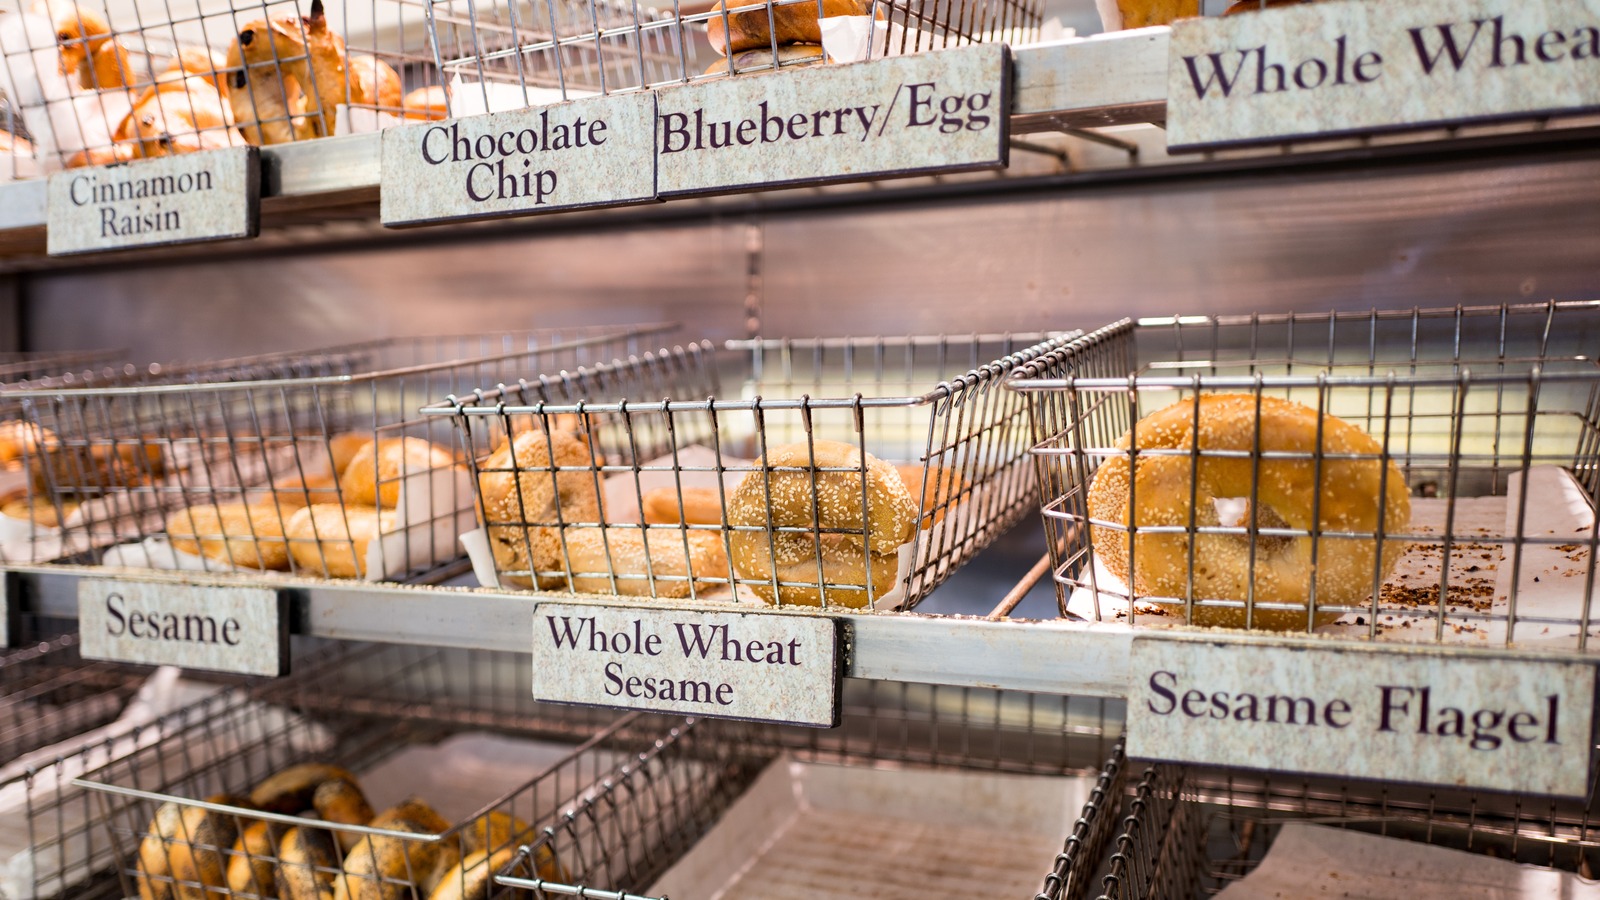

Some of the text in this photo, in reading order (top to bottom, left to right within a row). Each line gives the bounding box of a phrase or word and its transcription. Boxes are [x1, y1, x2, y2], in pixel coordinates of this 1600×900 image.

[1181, 35, 1383, 101] Whole
[421, 110, 608, 165] Chocolate
[660, 83, 991, 154] Blueberry/Egg
[69, 167, 213, 208] Cinnamon
[466, 157, 558, 205] Chip
[99, 203, 181, 238] Raisin
[105, 593, 241, 646] Sesame
[546, 615, 802, 667] Whole Wheat
[604, 662, 735, 706] Sesame
[1147, 670, 1562, 751] Sesame Flagel
